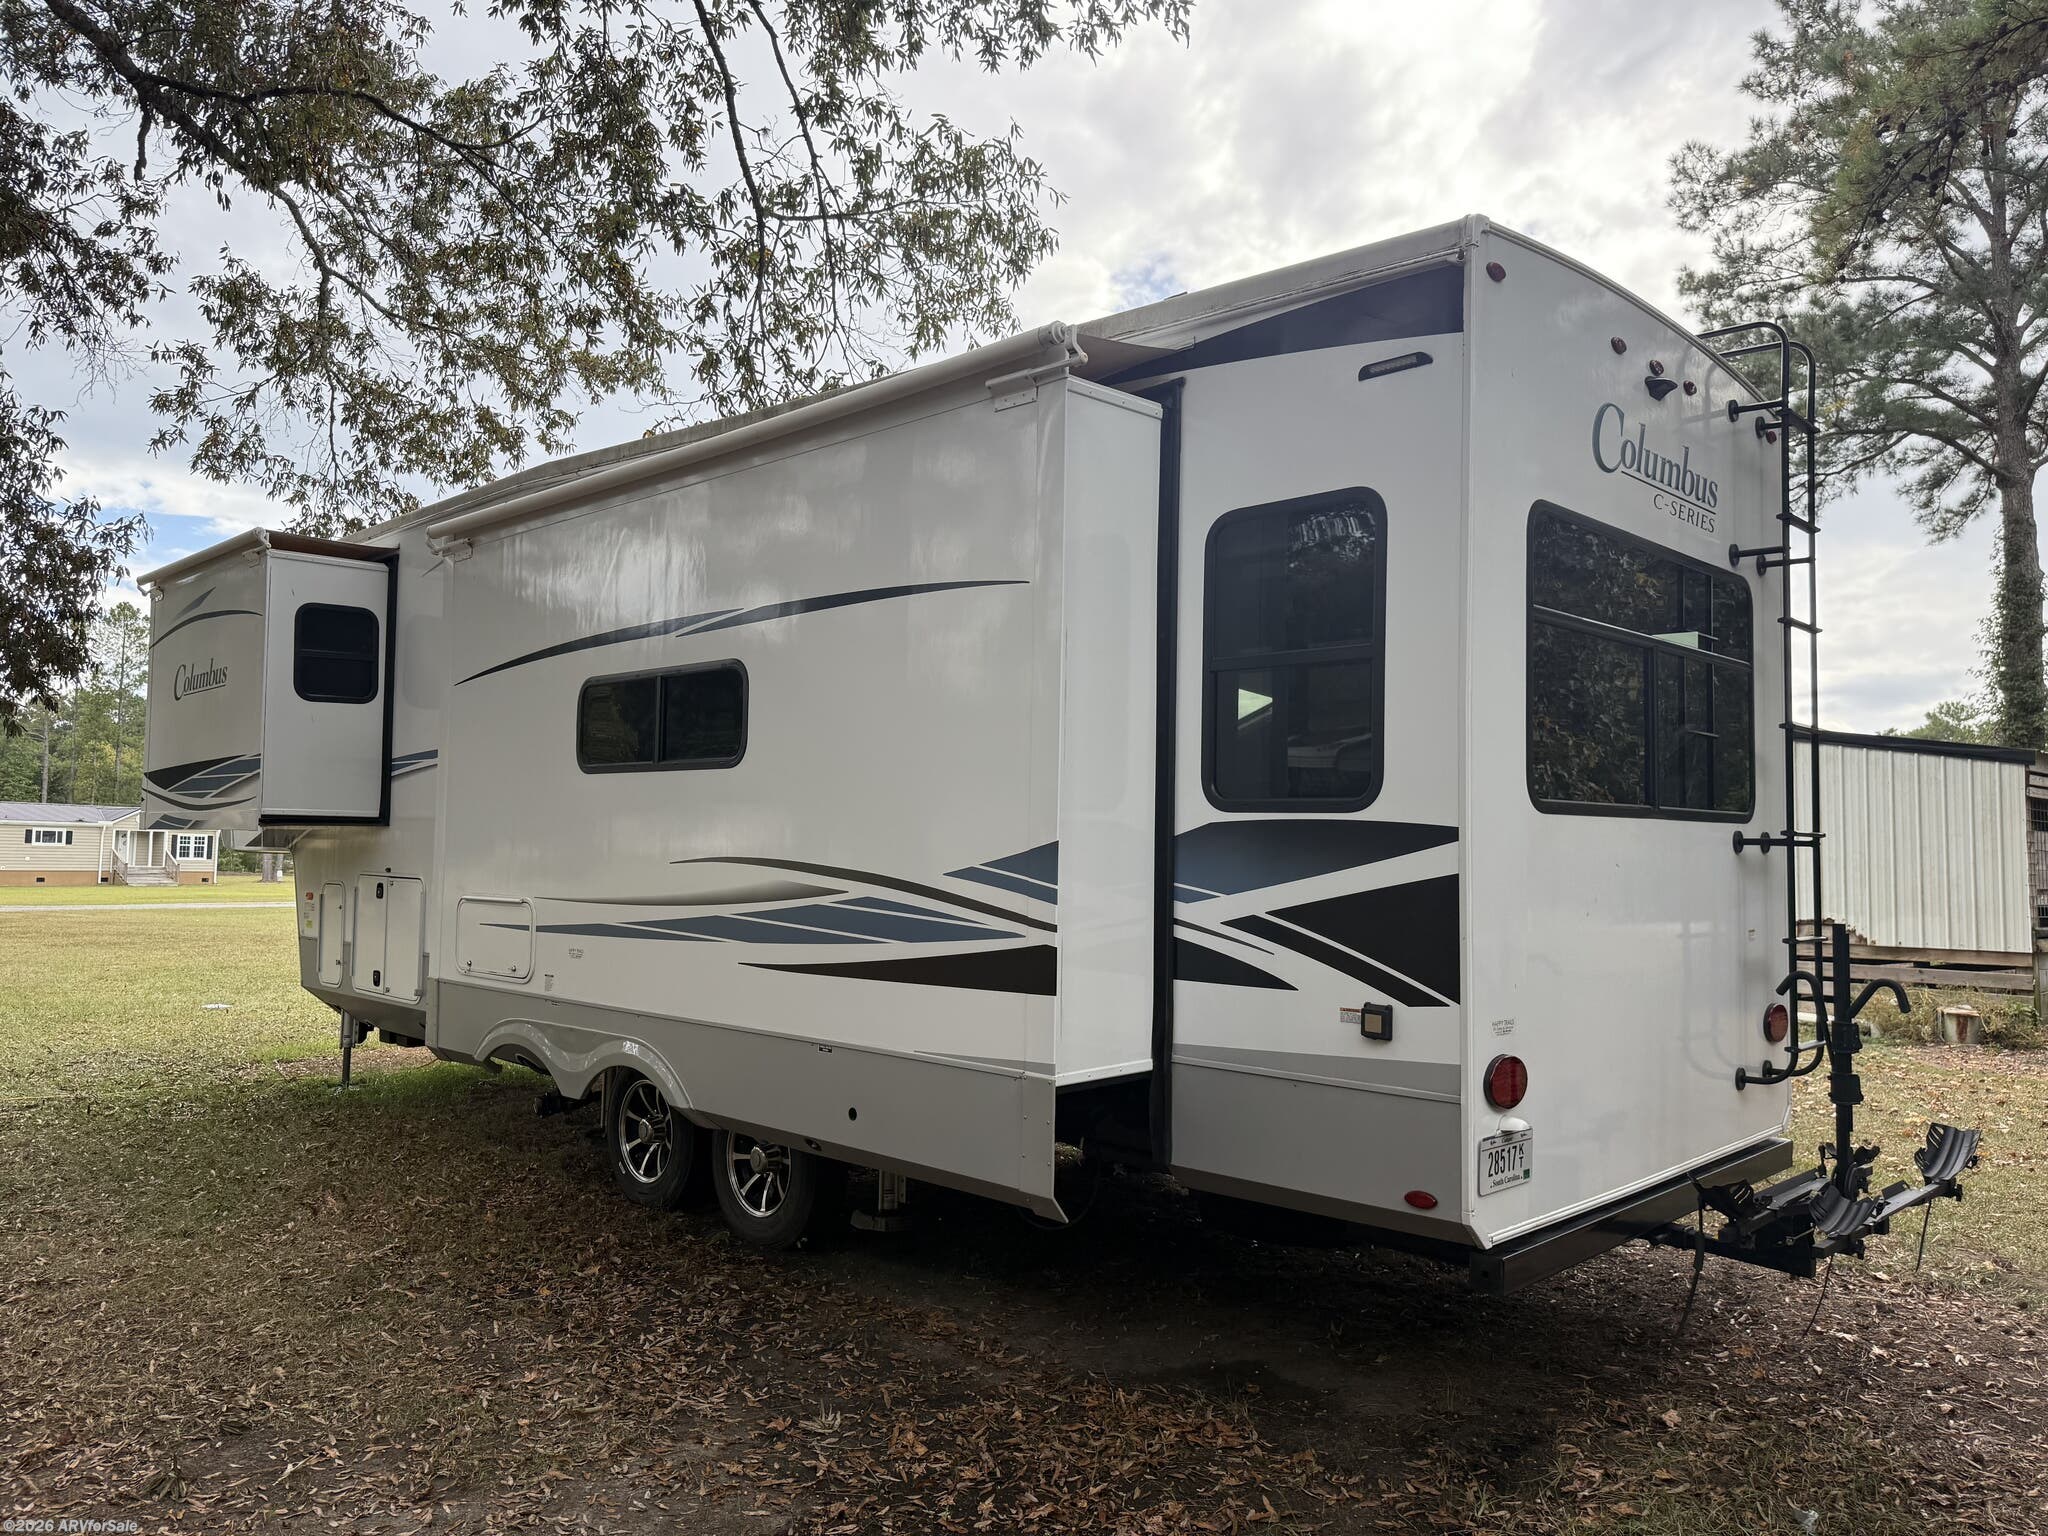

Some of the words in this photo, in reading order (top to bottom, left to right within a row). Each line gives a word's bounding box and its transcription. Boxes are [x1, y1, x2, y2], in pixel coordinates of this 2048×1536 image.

[1592, 402, 1719, 509] Columbus
[1653, 493, 1716, 533] C-SERIES
[174, 658, 228, 701] Columbus
[1488, 1145, 1517, 1177] 28517
